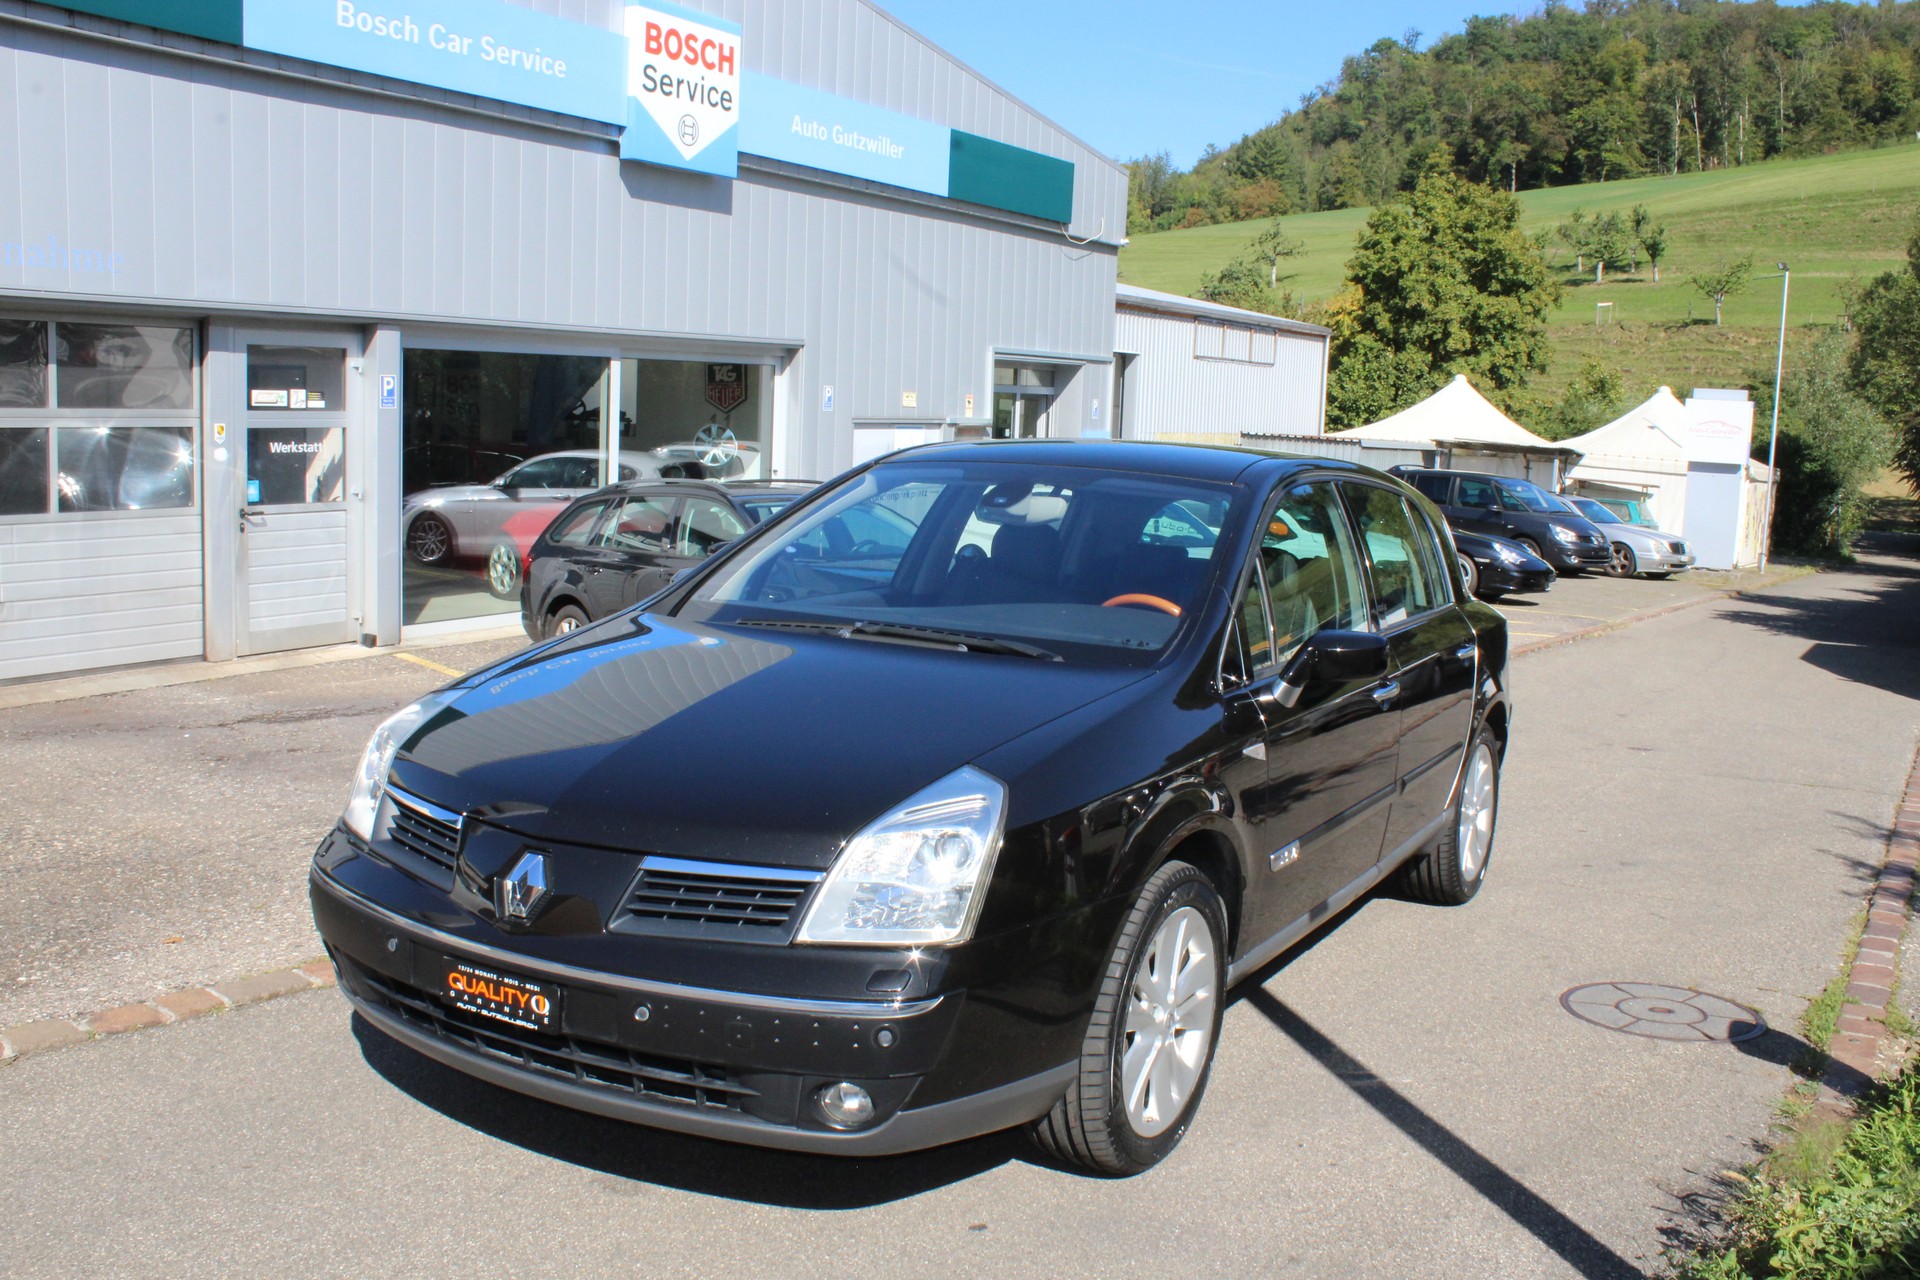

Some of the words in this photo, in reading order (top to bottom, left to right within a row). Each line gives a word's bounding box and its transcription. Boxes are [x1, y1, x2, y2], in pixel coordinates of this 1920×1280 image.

[336, 0, 420, 45] Bosch
[428, 23, 473, 57] Car
[480, 36, 568, 78] Service
[644, 21, 735, 76] BOSCH
[642, 64, 733, 112] Service
[790, 114, 828, 141] Auto
[832, 124, 905, 160] Gutzwiller
[713, 365, 737, 382] TAG
[708, 386, 741, 407] HEUER
[269, 441, 323, 454] Werkstatt
[449, 972, 530, 1009] QUALITY
[474, 969, 498, 981] MONATE
[504, 977, 519, 987] MOIS
[525, 983, 541, 992] MESI
[449, 990, 549, 1025] GARANTIE
